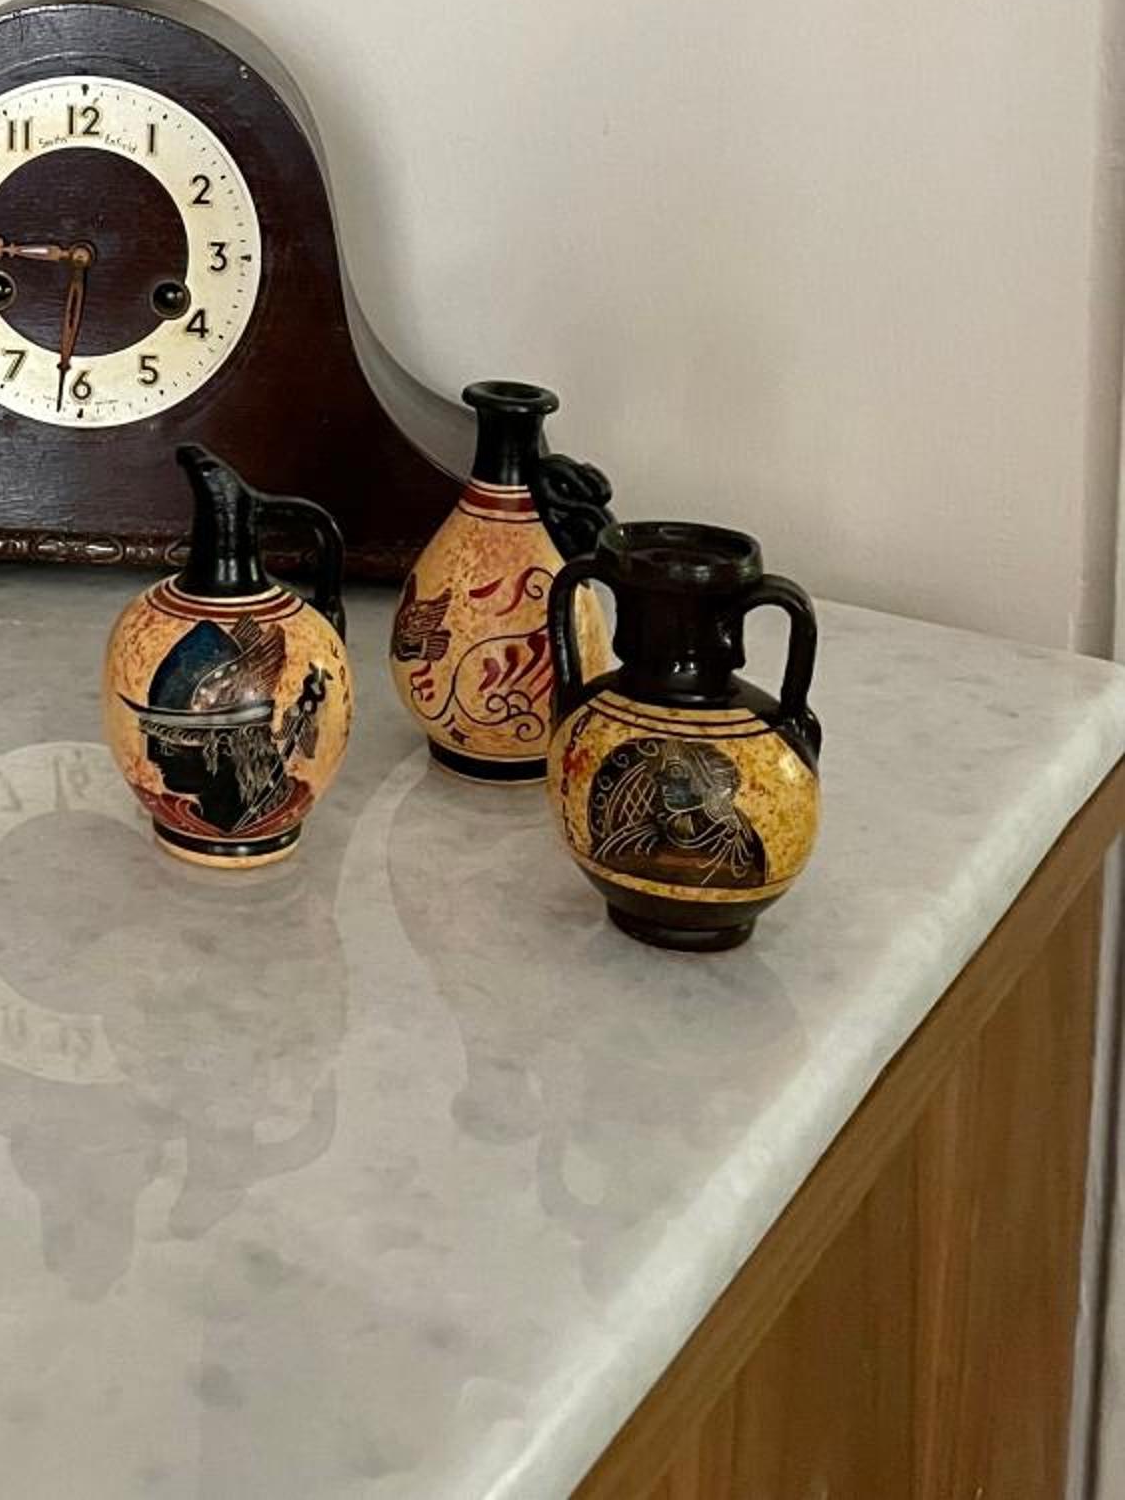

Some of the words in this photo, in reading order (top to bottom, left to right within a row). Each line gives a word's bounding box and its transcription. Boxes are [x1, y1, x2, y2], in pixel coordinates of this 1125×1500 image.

[8, 119, 31, 150] 11
[68, 105, 100, 135] 12
[148, 123, 156, 153] 1
[191, 175, 211, 205] 2
[209, 241, 228, 272] 3
[185, 308, 209, 339] 4
[4, 349, 27, 380] 7
[139, 355, 159, 385] 5
[72, 371, 92, 400] 6
